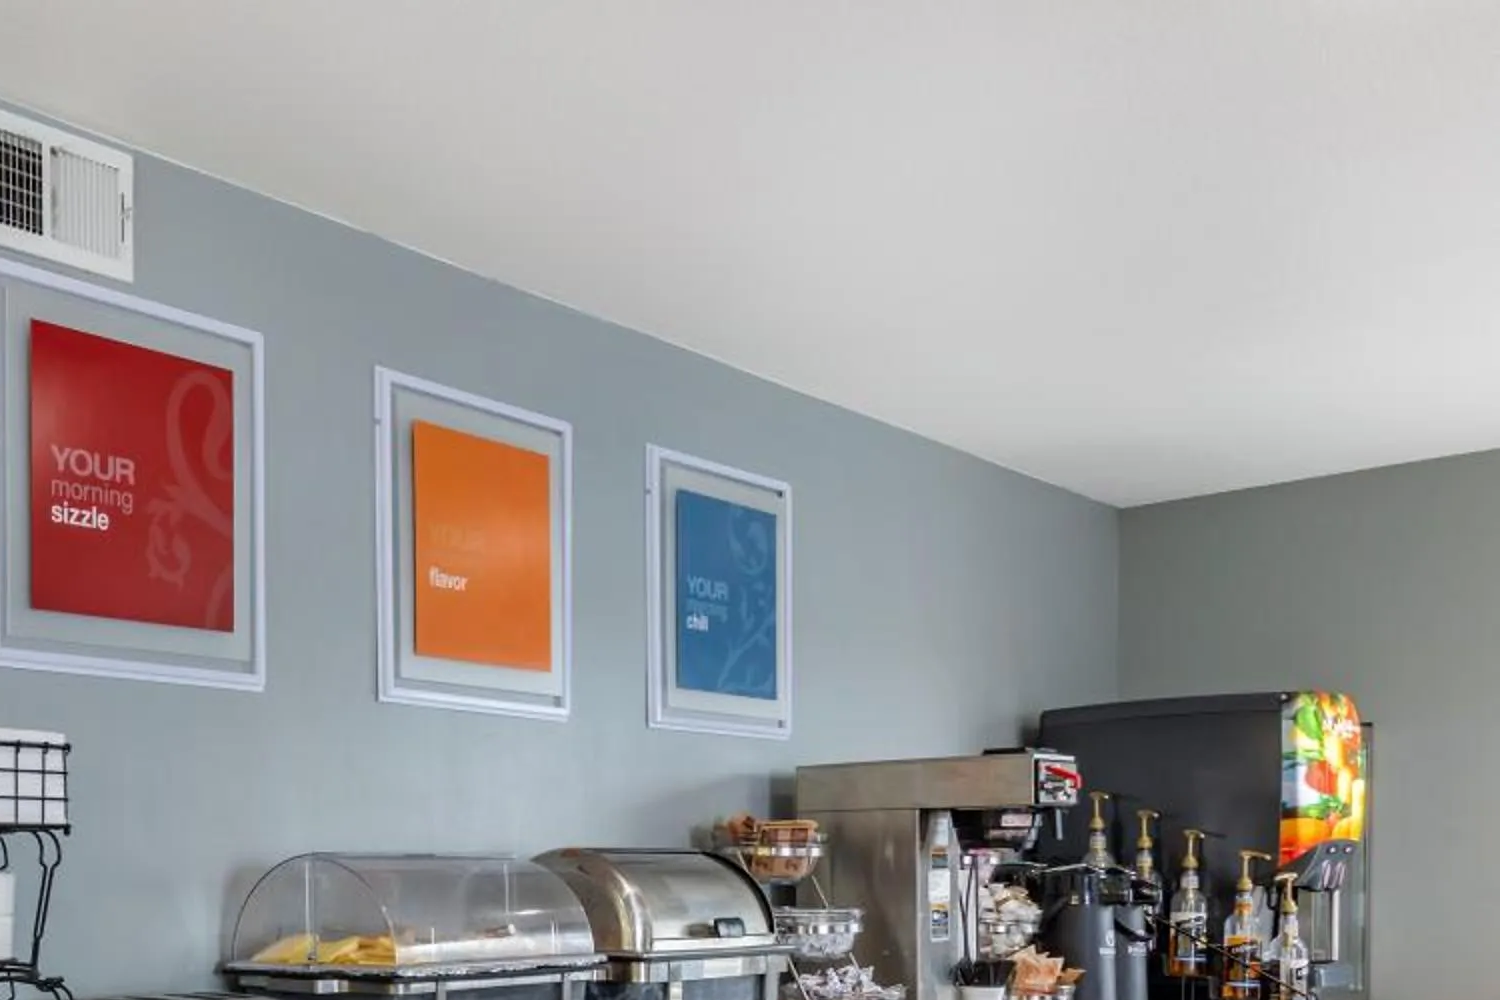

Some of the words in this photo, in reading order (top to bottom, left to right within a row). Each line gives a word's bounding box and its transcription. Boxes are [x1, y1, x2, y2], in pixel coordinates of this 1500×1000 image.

[50, 444, 136, 485] YOUR
[50, 478, 134, 516] morning
[50, 500, 110, 531] sizzle
[429, 565, 469, 592] flavor
[686, 573, 729, 601] YOUR
